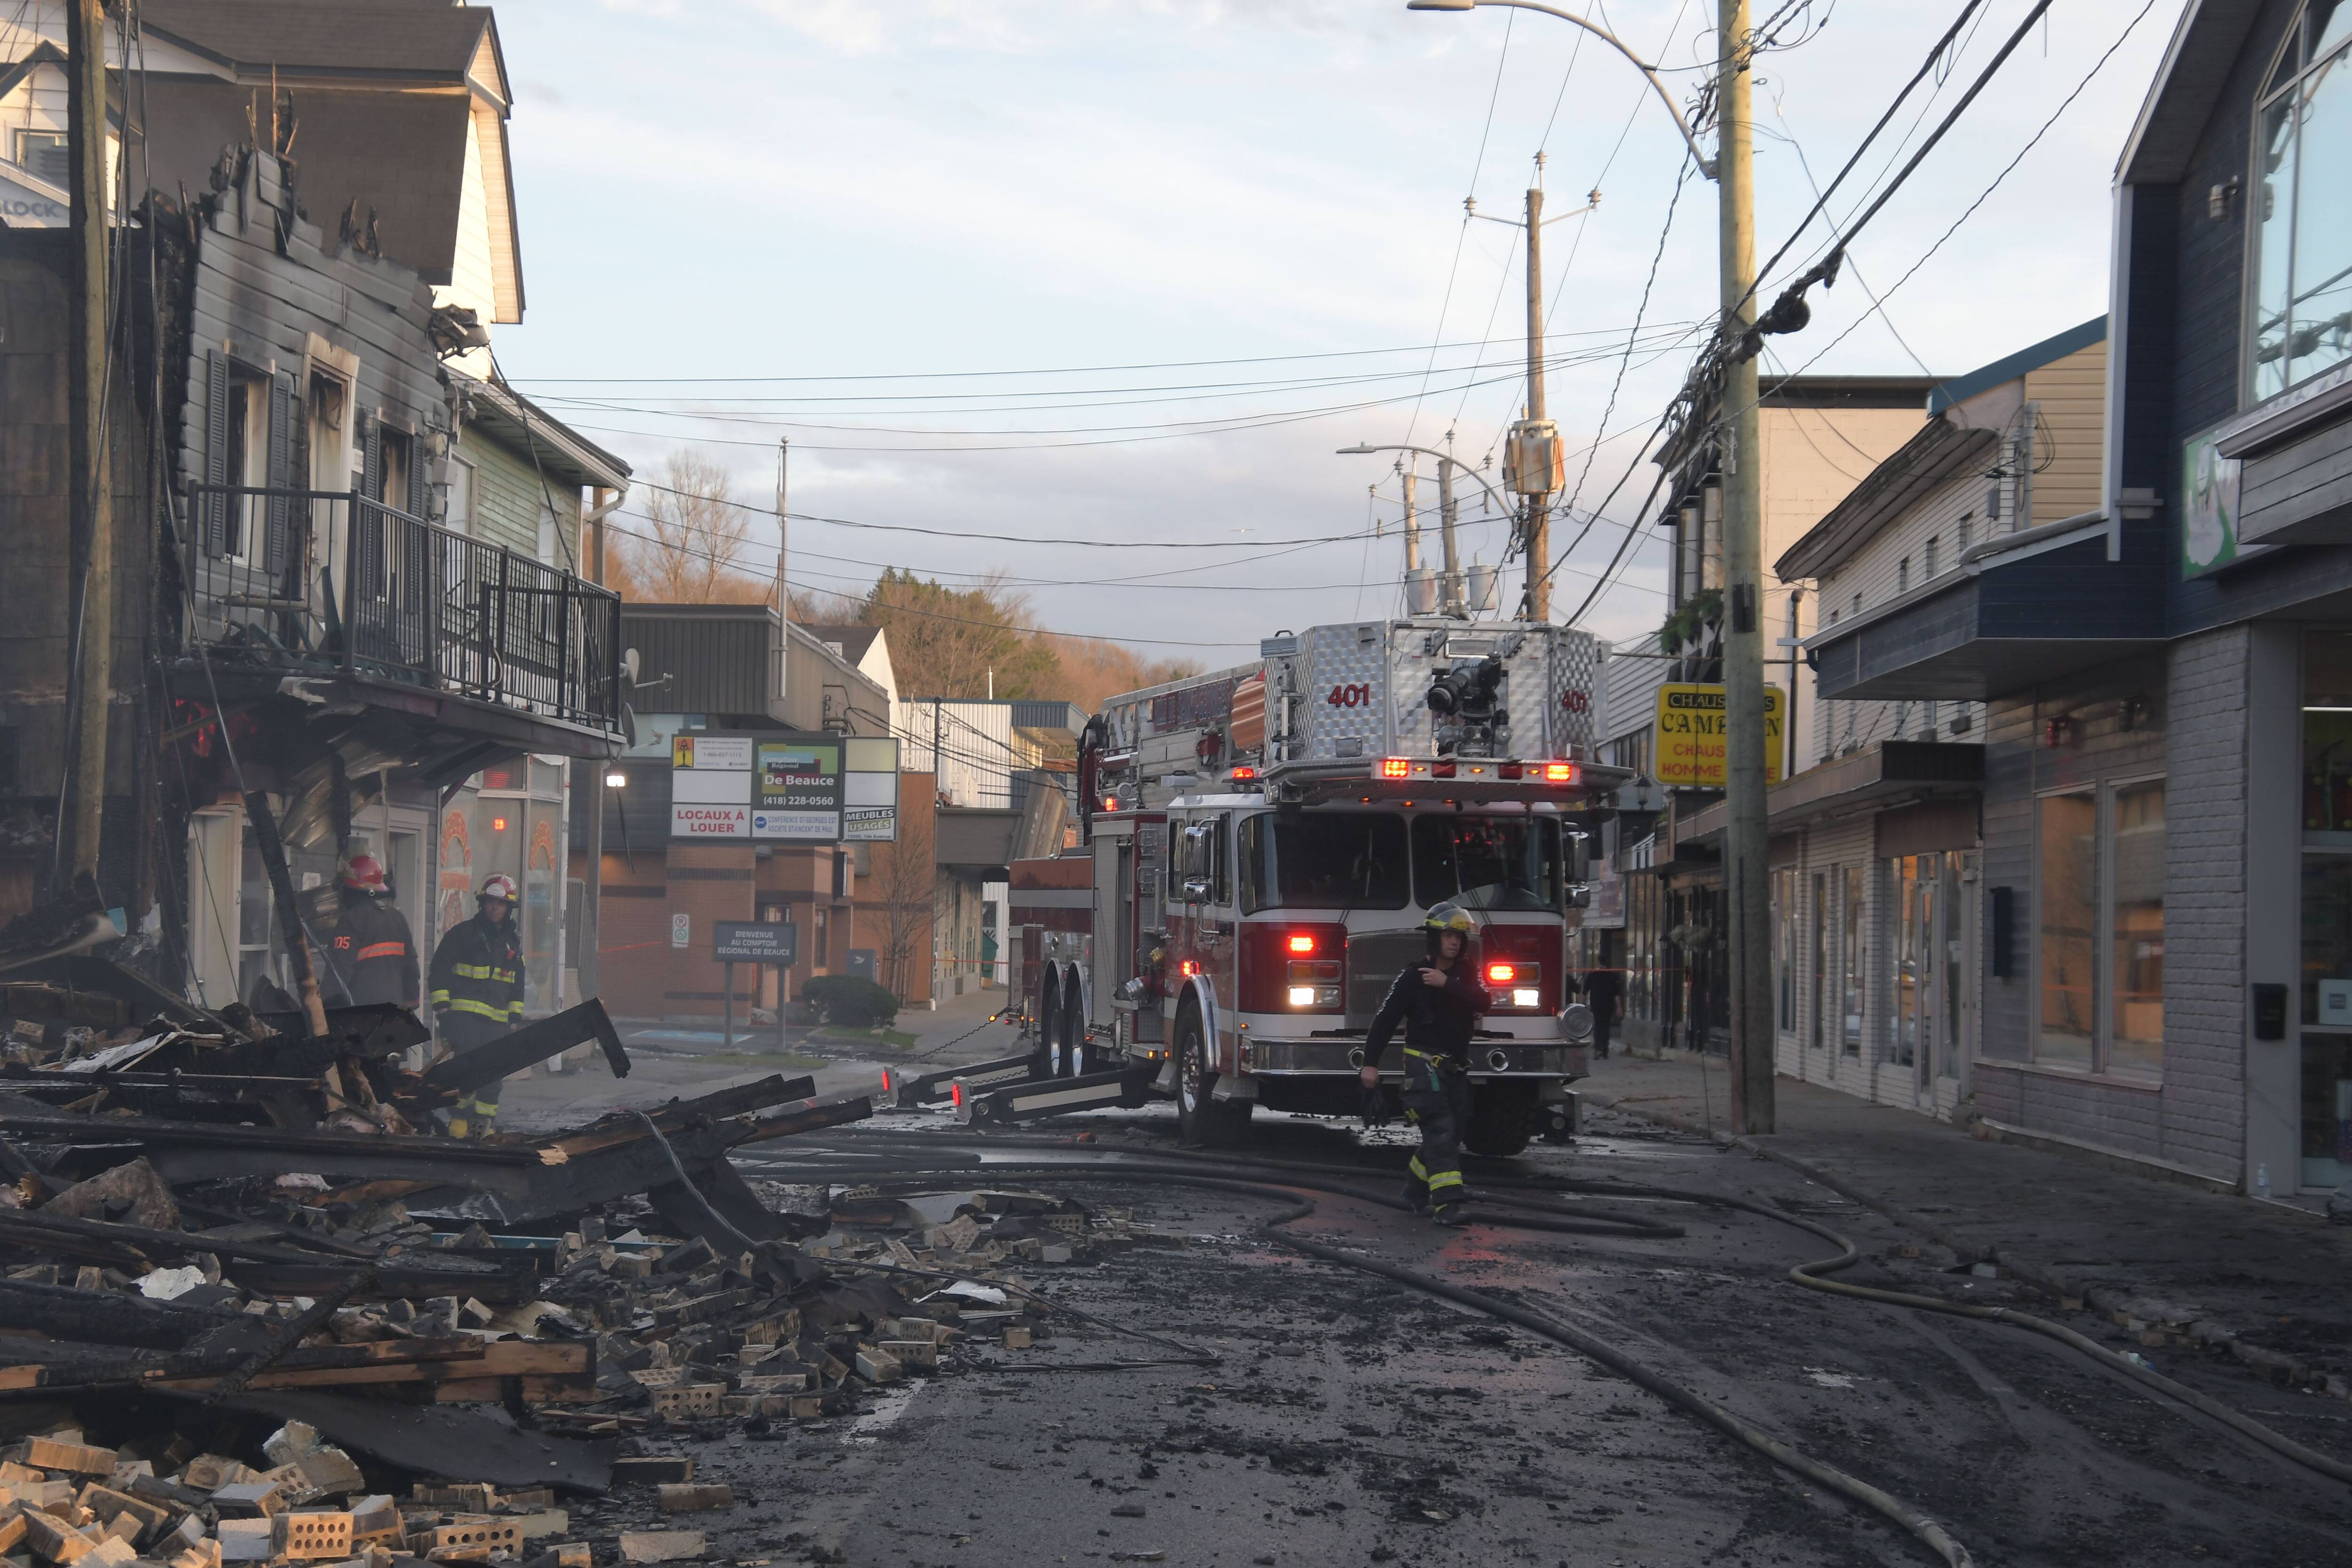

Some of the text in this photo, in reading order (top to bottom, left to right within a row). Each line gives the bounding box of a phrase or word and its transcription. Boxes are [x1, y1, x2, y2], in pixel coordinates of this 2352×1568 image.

[0, 200, 60, 217] LOCK
[1328, 684, 1369, 708] 401
[1562, 689, 1587, 714] 401
[1670, 694, 1773, 709] CHAUSS
[1662, 713, 1780, 737] CAMN
[1662, 763, 1722, 777] HOMME
[764, 775, 834, 786] De Beauce
[763, 796, 834, 806] (418) 228-0560
[677, 809, 744, 820] LOCAUX À
[846, 809, 894, 821] MEUBLES
[690, 822, 735, 832] LOUER
[850, 820, 890, 831] USAGÉS
